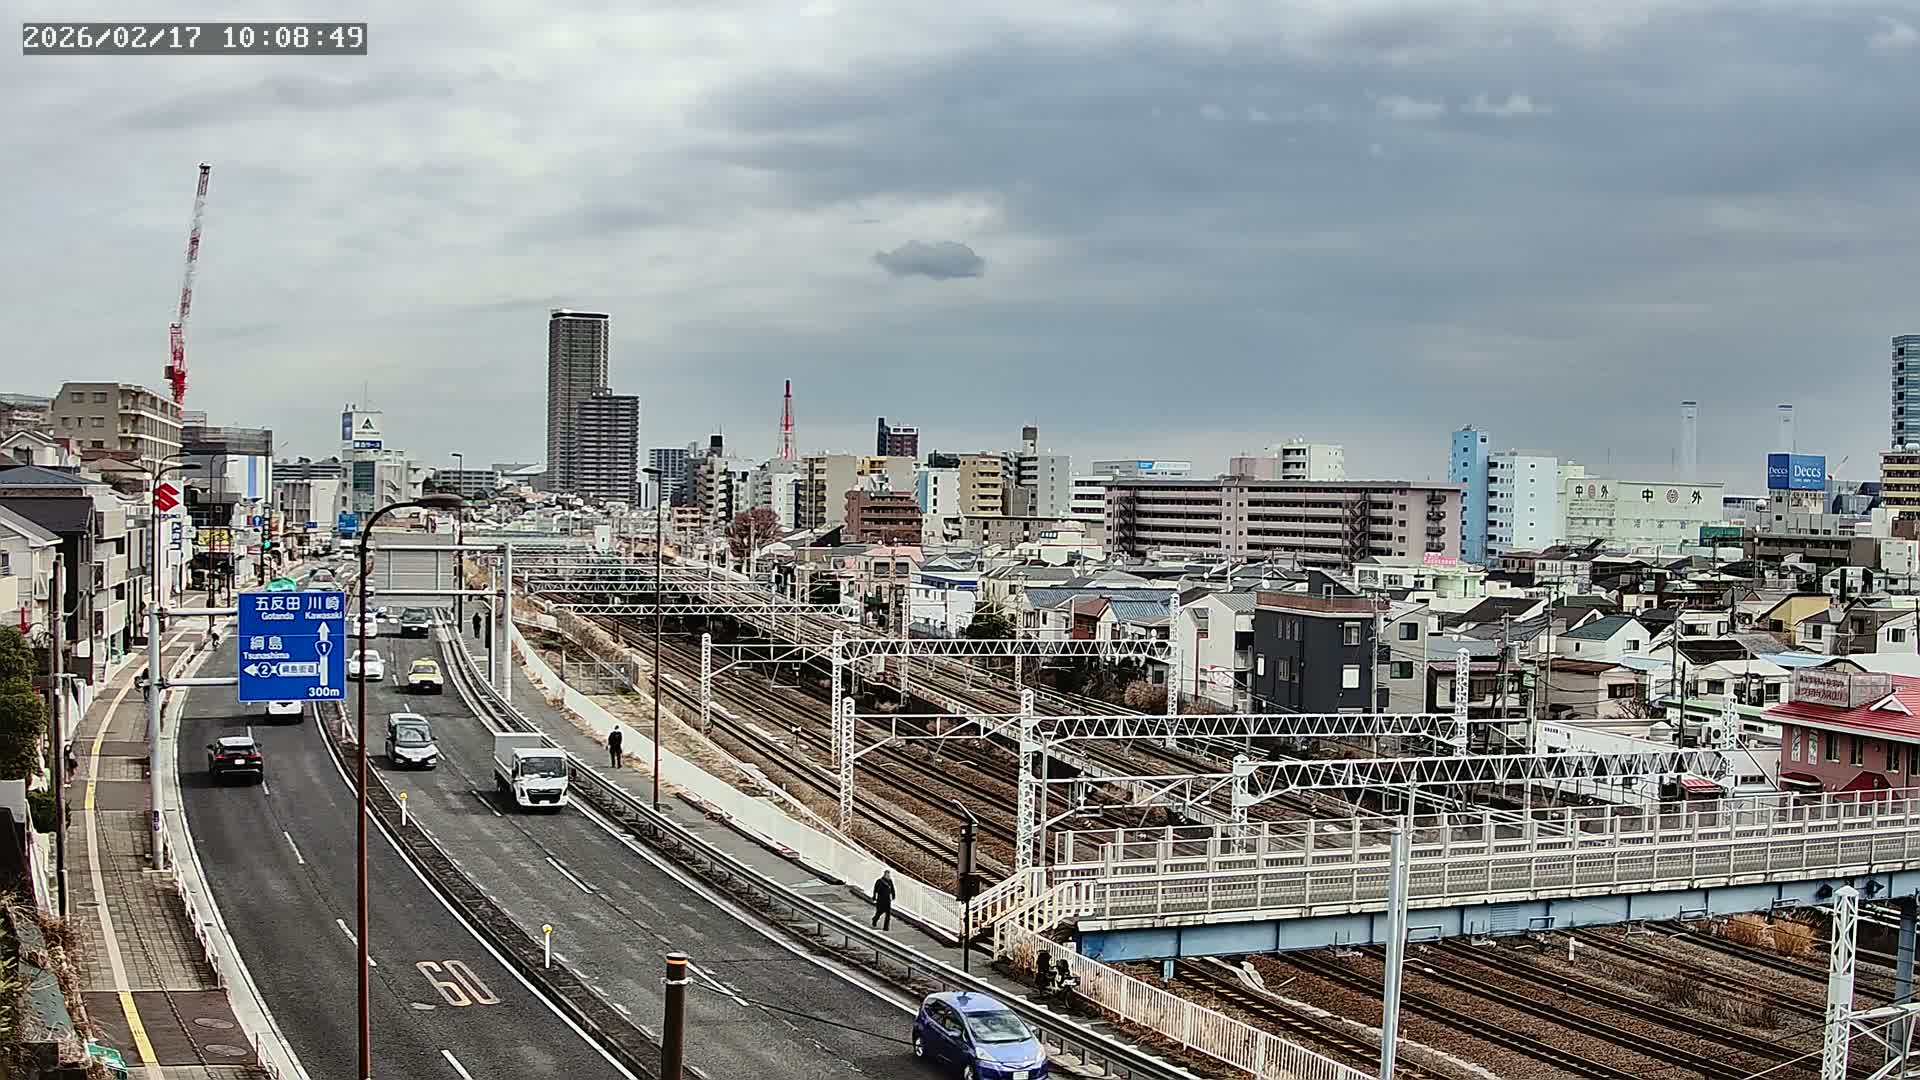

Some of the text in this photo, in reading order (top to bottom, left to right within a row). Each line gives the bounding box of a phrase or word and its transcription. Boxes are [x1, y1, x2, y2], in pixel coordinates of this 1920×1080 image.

[1794, 464, 1822, 478] Deccs
[1641, 488, 1703, 504] 中 外
[255, 596, 300, 611] 五反田
[321, 643, 327, 653] 1
[261, 666, 269, 675] 2
[308, 687, 340, 697] 300m
[415, 960, 501, 1007] 60
